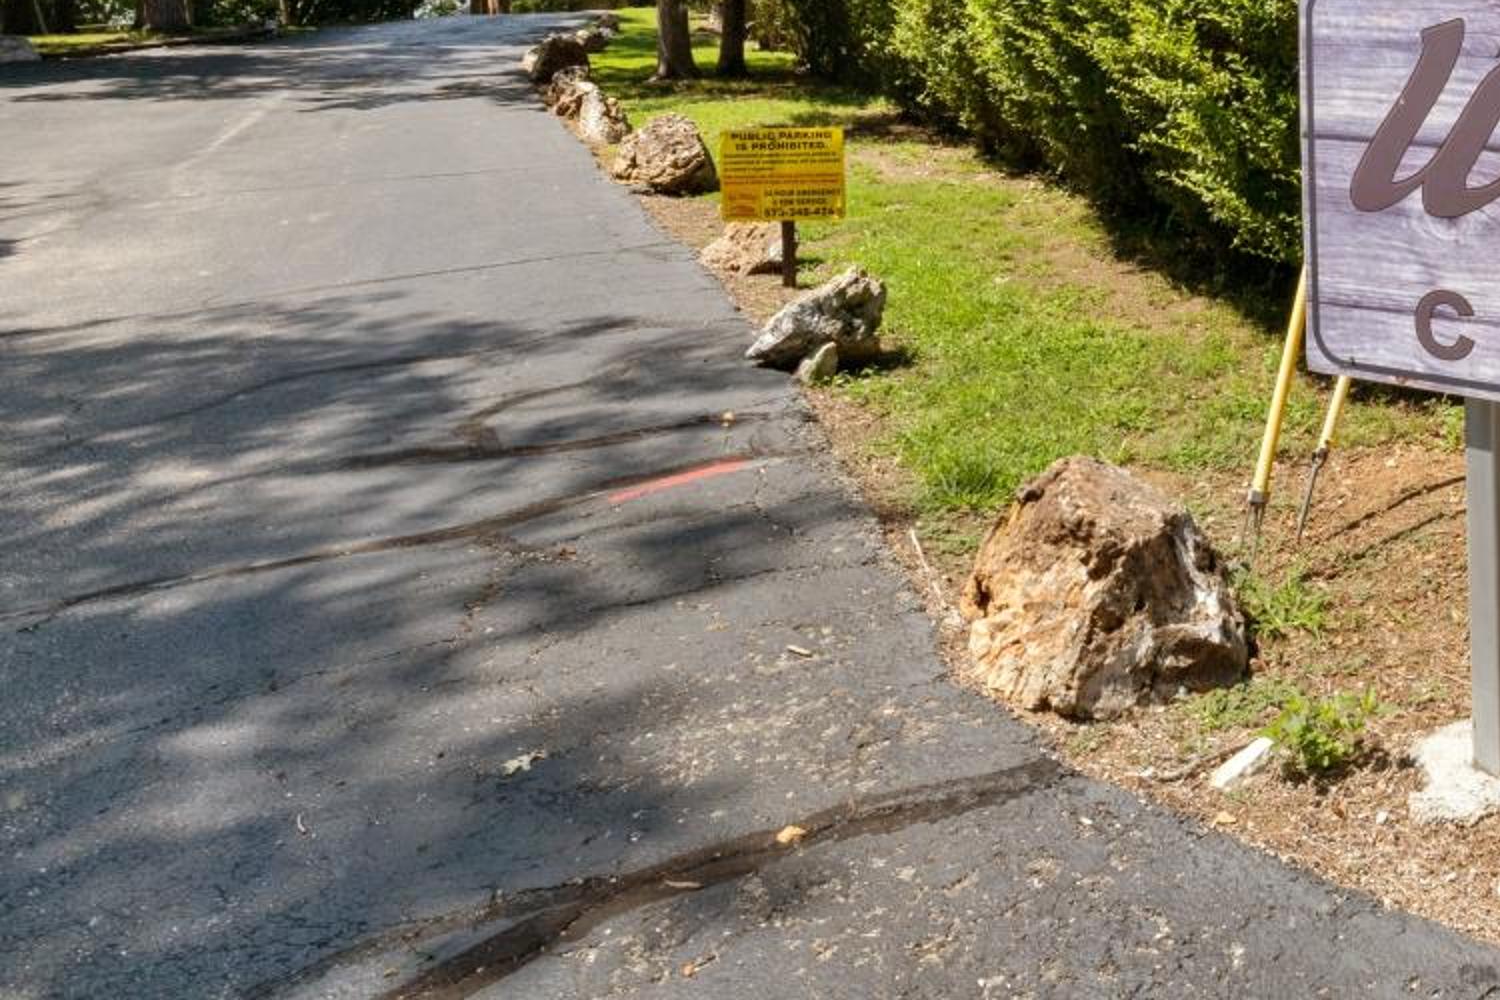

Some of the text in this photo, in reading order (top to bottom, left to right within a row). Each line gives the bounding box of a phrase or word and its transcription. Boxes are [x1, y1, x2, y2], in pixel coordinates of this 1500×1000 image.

[730, 130, 832, 141] PUBLIC PARKING
[735, 142, 748, 151] IS
